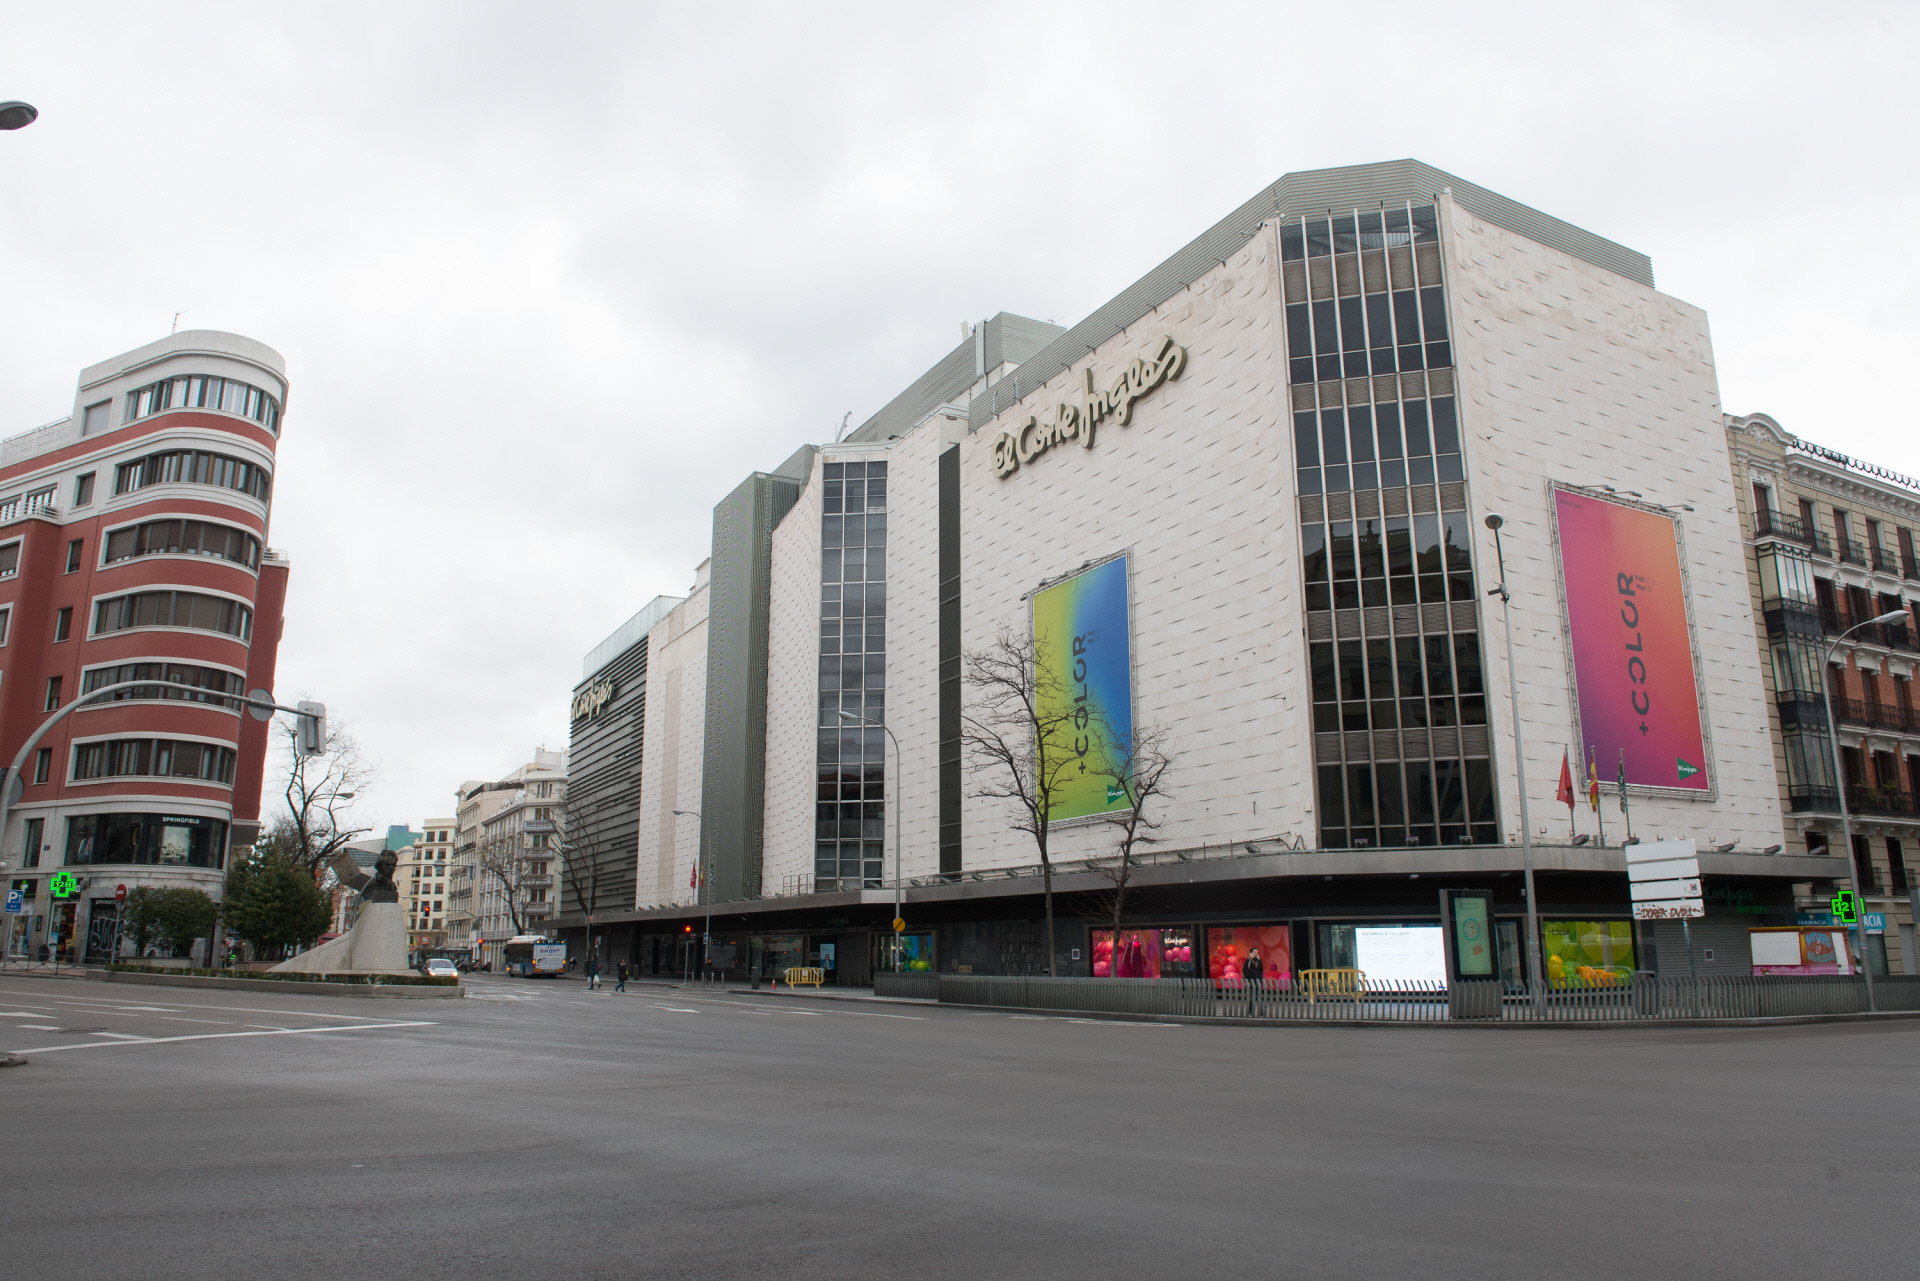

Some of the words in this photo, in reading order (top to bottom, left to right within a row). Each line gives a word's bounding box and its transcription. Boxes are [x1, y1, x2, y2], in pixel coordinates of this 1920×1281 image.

[991, 431, 1019, 479] El
[1015, 403, 1080, 464] Corte
[1635, 574, 1645, 583] Feb
[162, 816, 200, 824] SPRINGFIELD
[8, 892, 18, 904] P
